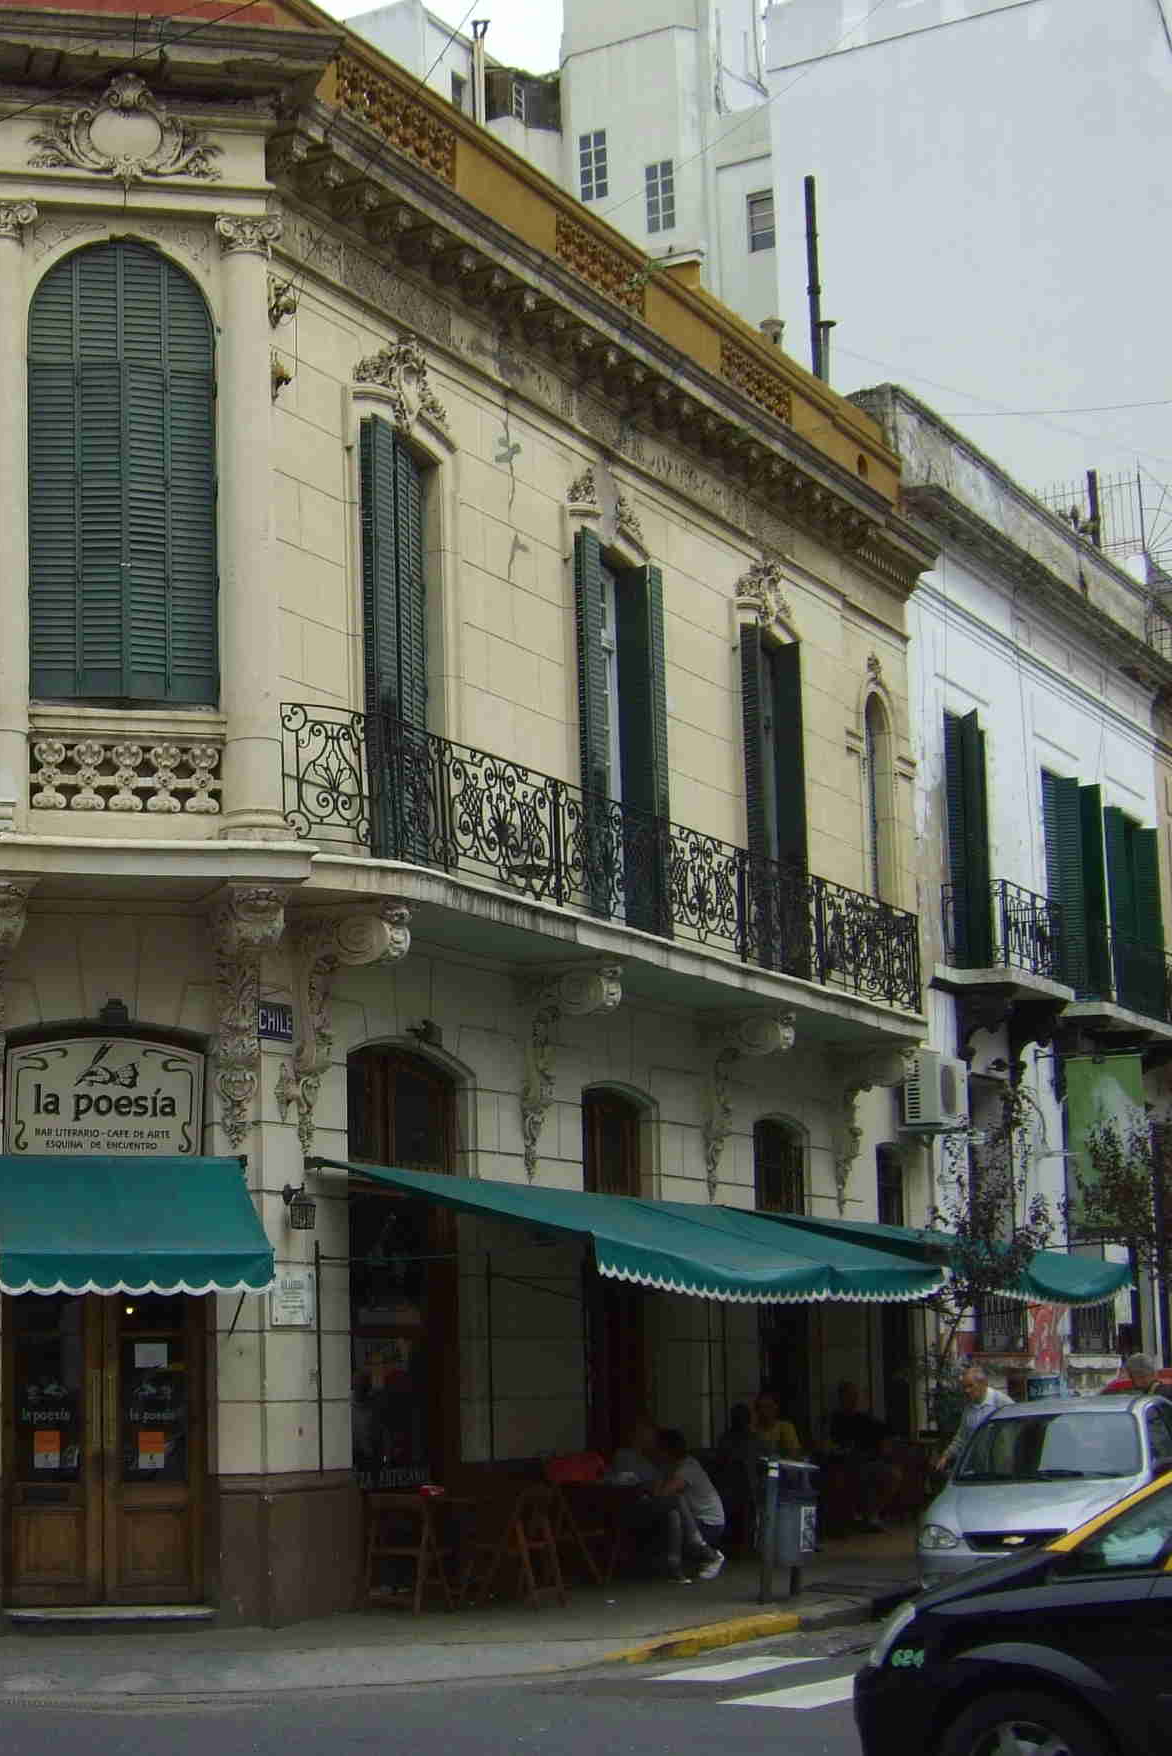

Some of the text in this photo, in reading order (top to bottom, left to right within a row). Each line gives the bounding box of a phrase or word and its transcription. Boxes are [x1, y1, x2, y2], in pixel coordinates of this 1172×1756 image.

[258, 1008, 293, 1033] CHILE
[33, 1083, 176, 1122] la poesía
[34, 1127, 53, 1137] BAR
[55, 1128, 100, 1138] LITERARIO
[133, 1129, 144, 1139] DE
[147, 1130, 171, 1139] ARTE
[45, 1139, 158, 1150] ESQUINA DE ENCUENTRO
